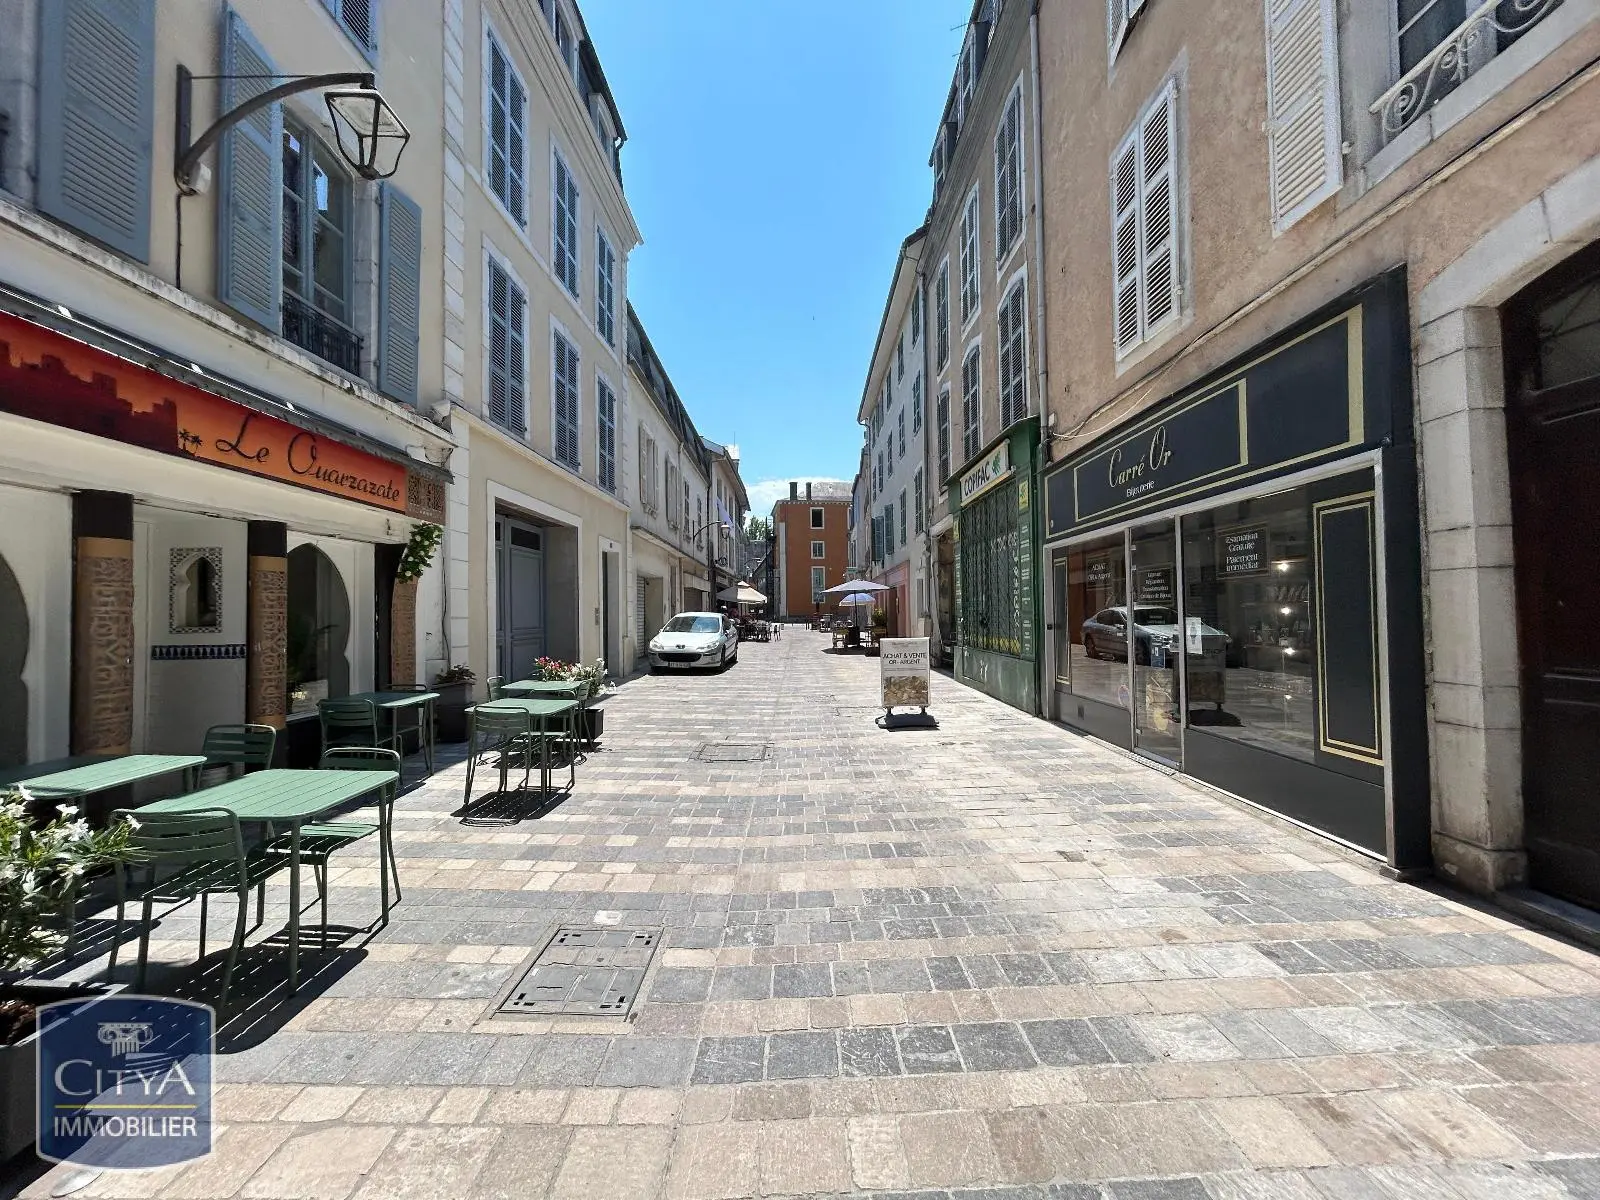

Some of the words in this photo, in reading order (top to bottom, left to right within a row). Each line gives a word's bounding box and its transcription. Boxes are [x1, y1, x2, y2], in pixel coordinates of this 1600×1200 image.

[215, 413, 270, 465] Le
[286, 431, 401, 503] Ouarzazate
[963, 460, 991, 497] COPIFAC
[1108, 448, 1146, 488] Carré
[1149, 425, 1172, 471] Or
